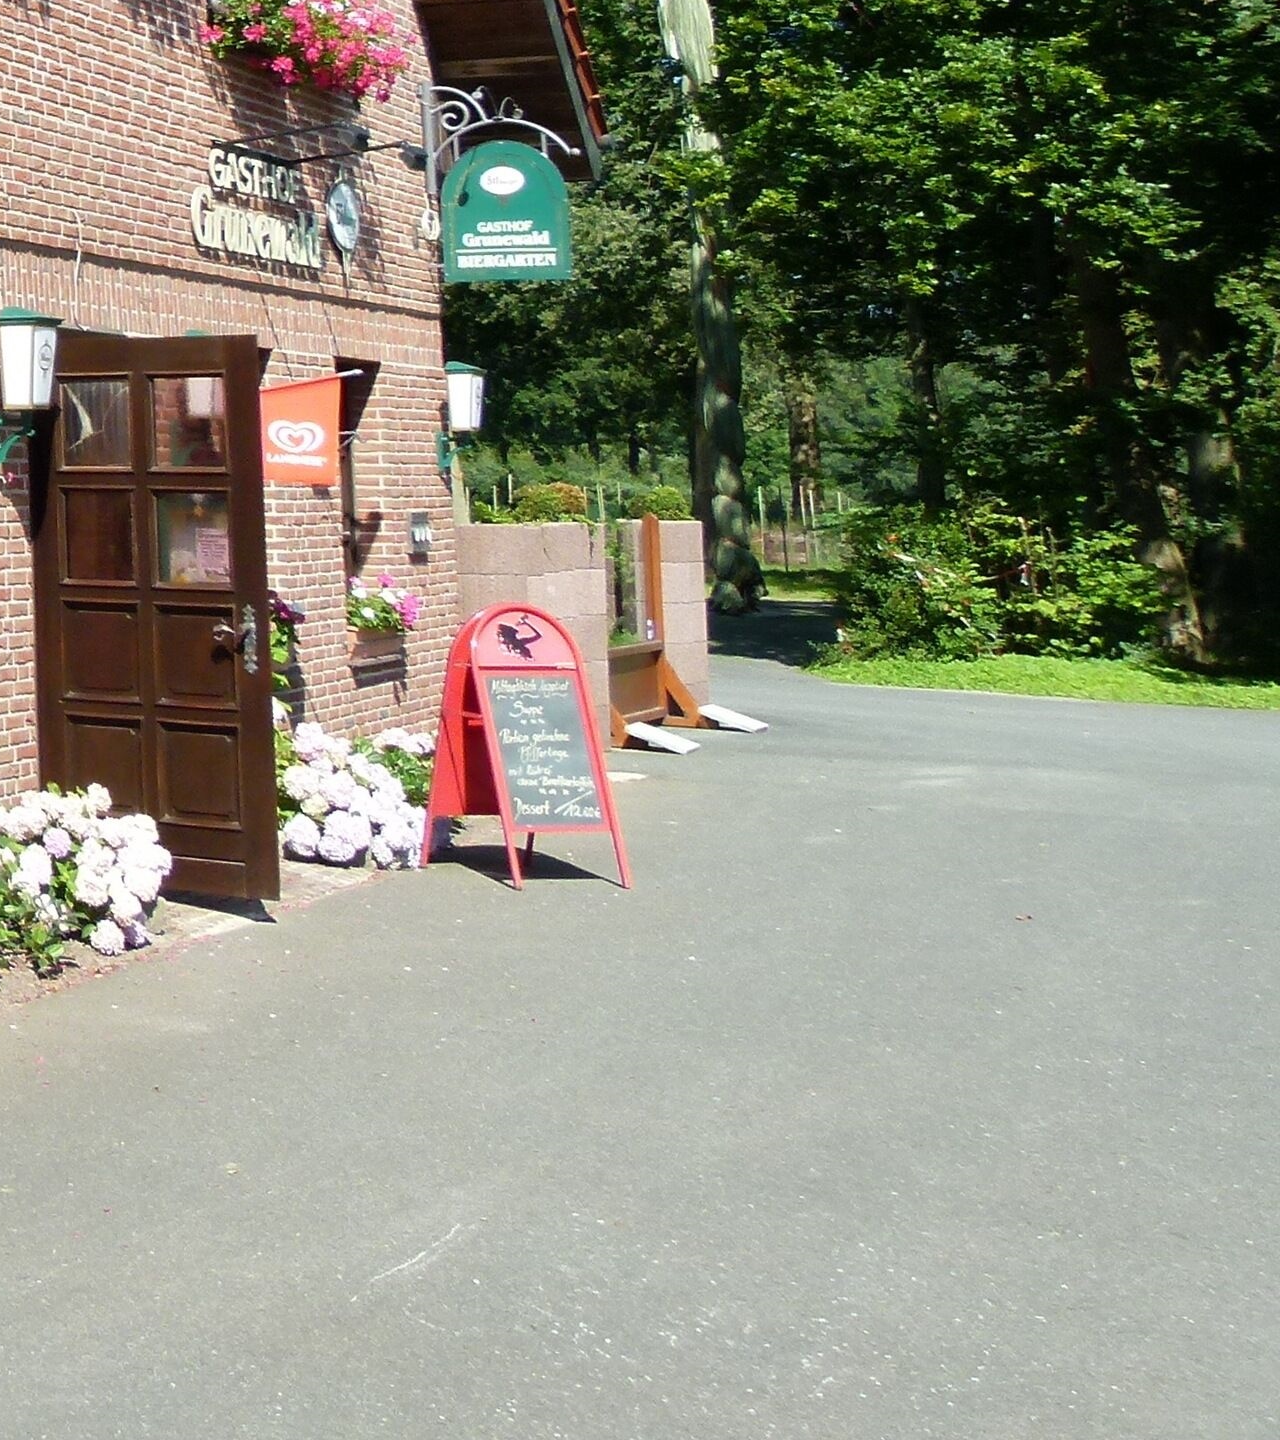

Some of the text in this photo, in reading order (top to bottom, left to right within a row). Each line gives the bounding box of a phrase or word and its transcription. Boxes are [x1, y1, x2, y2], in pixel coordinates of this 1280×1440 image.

[209, 148, 301, 204] GASTHOF
[191, 185, 322, 269] Grunewald
[477, 220, 533, 233] GASTHOF
[462, 230, 550, 247] Grunewald
[457, 253, 557, 268] BIERGARTEN
[509, 700, 544, 718] Suppe
[499, 728, 529, 744] Portion
[513, 797, 550, 820] Dessert
